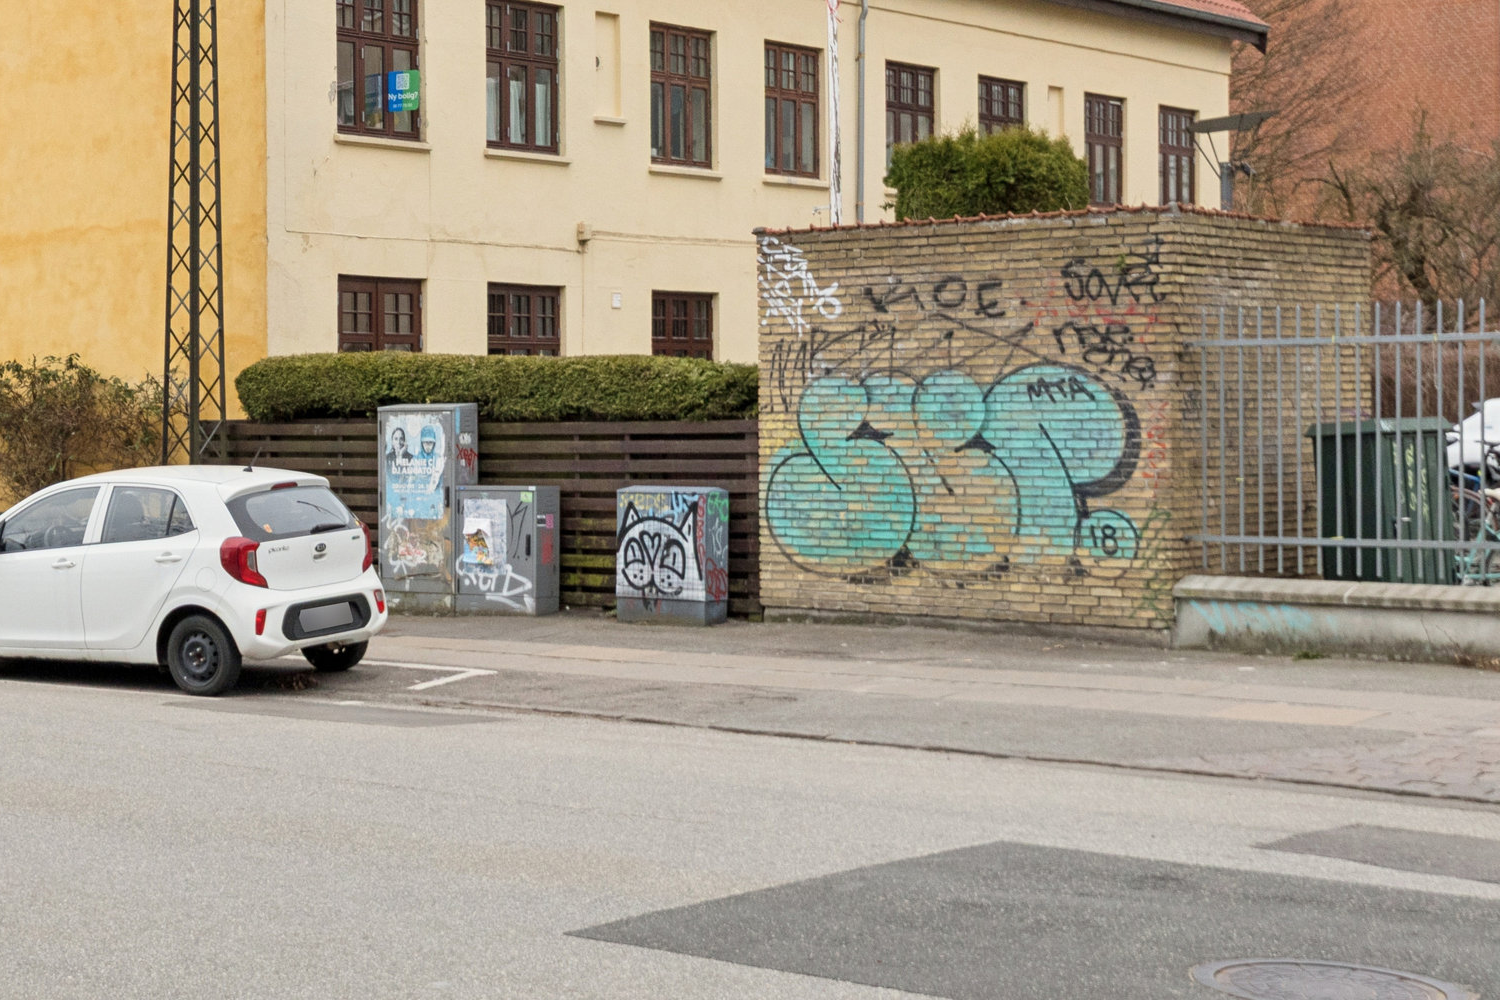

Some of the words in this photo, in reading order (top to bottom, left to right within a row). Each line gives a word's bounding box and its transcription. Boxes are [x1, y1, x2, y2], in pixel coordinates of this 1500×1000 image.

[388, 93, 397, 101] Ny
[398, 91, 418, 100] bolig?
[1027, 376, 1096, 403] MTA
[392, 466, 401, 474] DJ
[1090, 524, 1119, 556] 18
